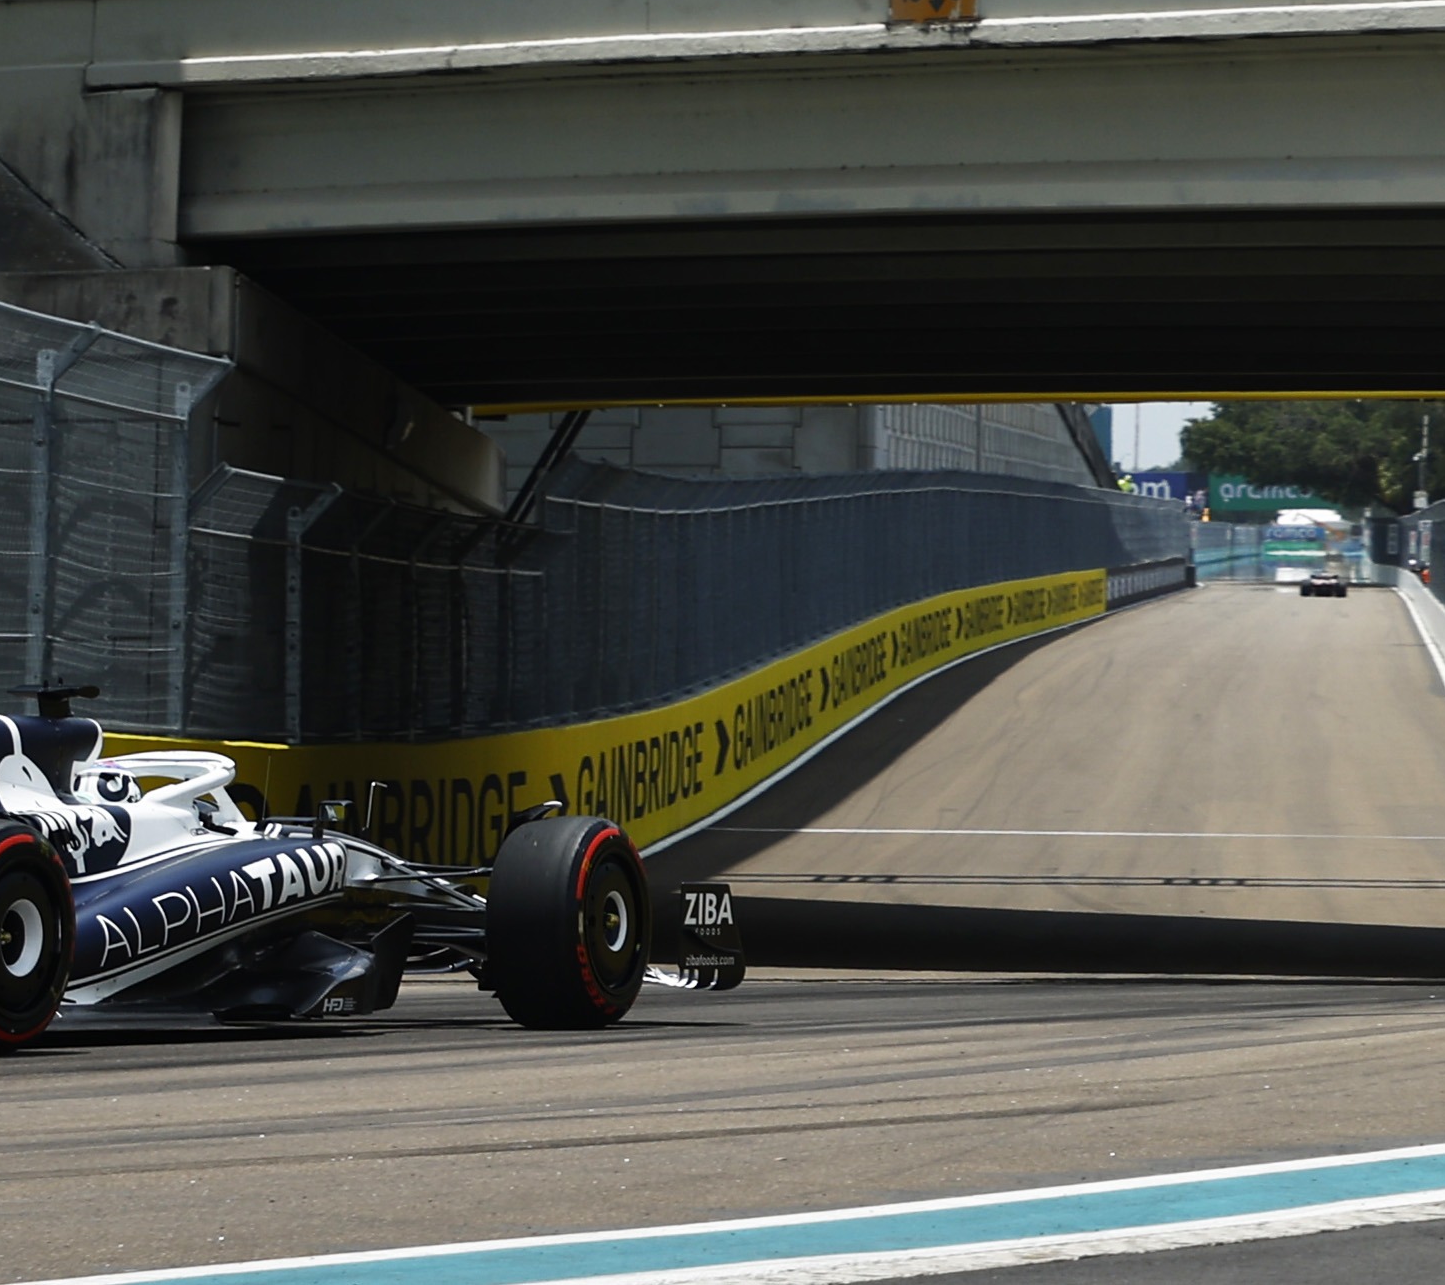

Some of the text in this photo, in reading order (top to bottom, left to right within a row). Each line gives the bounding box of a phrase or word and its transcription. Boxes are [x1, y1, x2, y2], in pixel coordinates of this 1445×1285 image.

[733, 669, 813, 770] GAINBRIDGE
[576, 721, 704, 824] GAINBRIDGE
[684, 893, 733, 925] ZIBA
[685, 954, 735, 966] zibafoods.com
